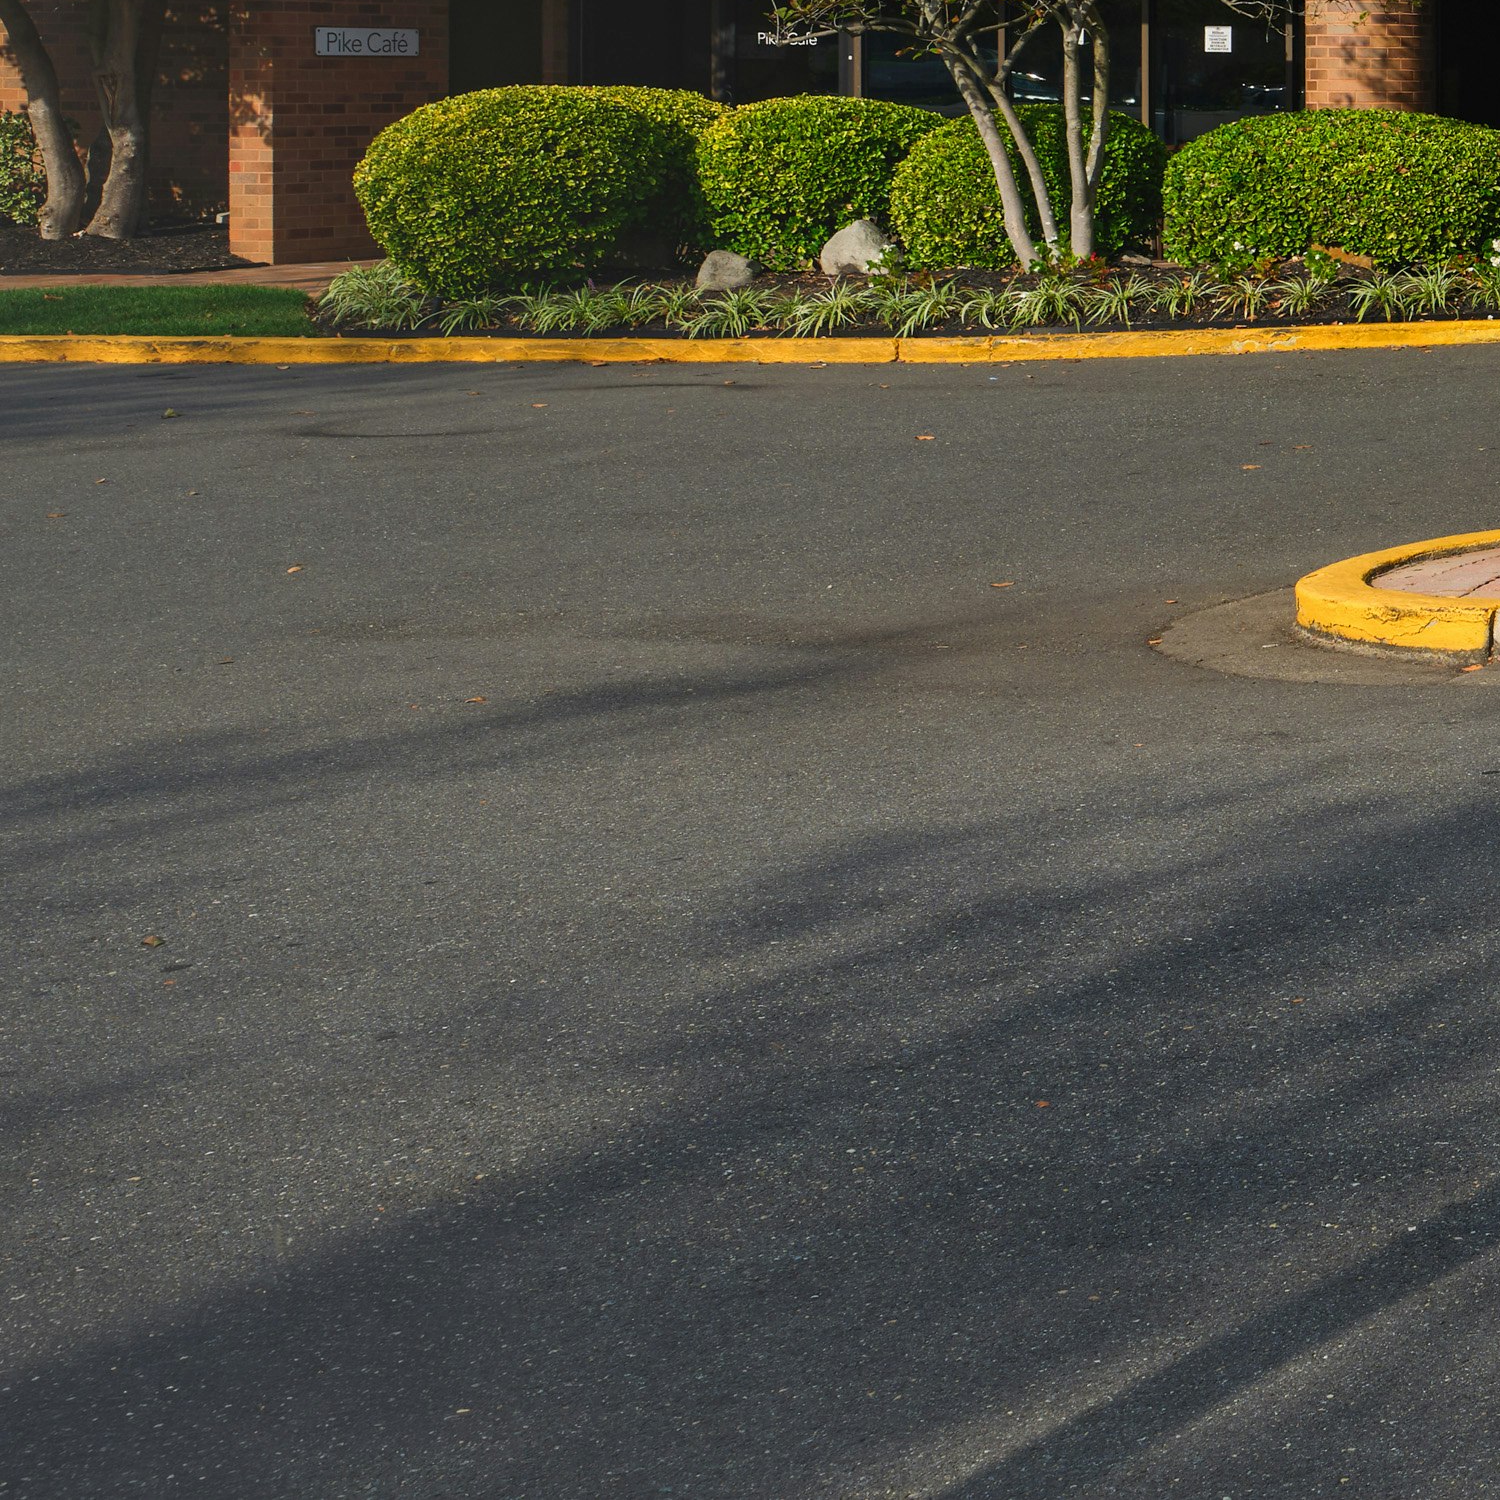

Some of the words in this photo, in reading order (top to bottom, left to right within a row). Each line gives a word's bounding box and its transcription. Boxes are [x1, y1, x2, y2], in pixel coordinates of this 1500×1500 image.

[326, 31, 362, 53] Pike
[367, 31, 408, 53] Café
[757, 32, 784, 46] Pik
